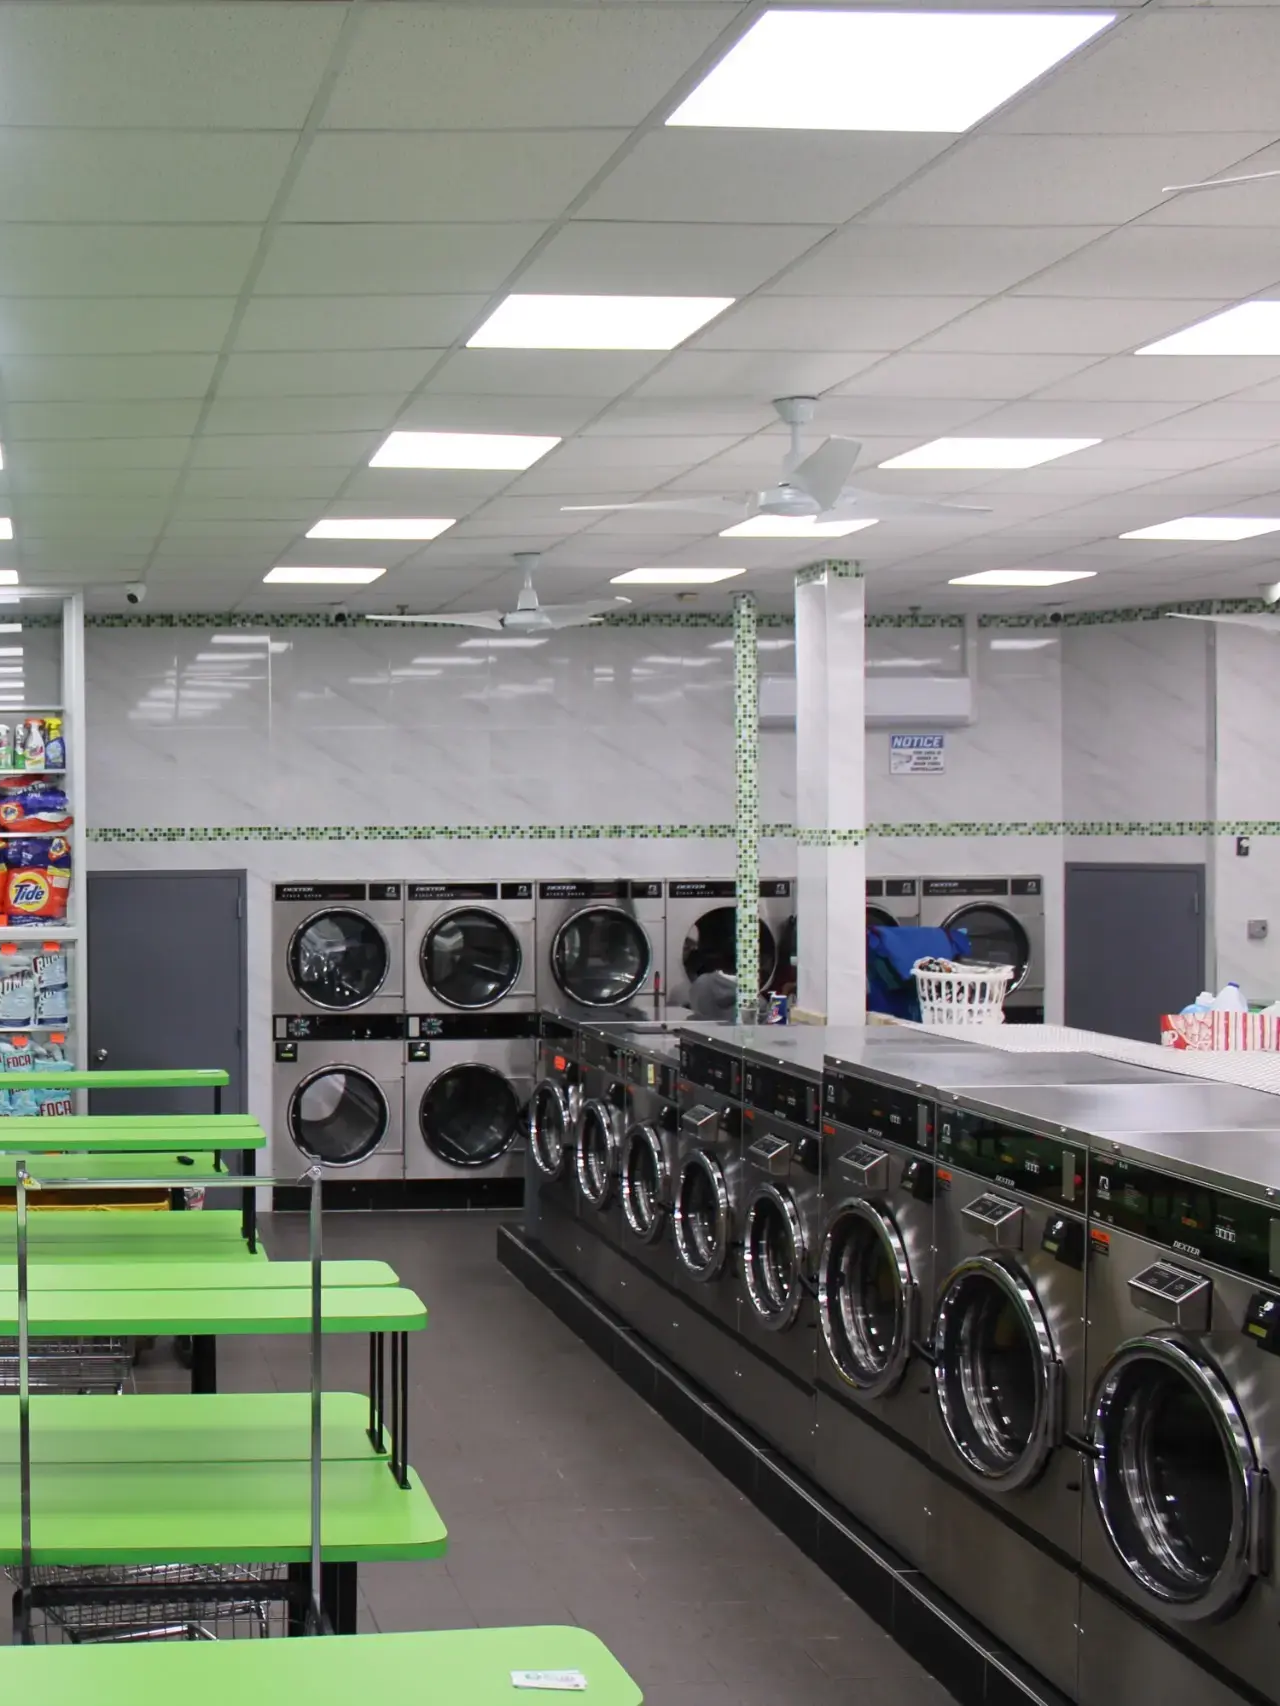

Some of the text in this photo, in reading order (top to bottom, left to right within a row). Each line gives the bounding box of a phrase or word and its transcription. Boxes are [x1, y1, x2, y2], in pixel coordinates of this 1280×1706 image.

[893, 736, 942, 747] NOTICE
[13, 883, 45, 905] Tide
[6, 1054, 32, 1069] FOCA
[40, 1100, 72, 1116] FOCA
[1172, 1240, 1201, 1257] DEXTER
